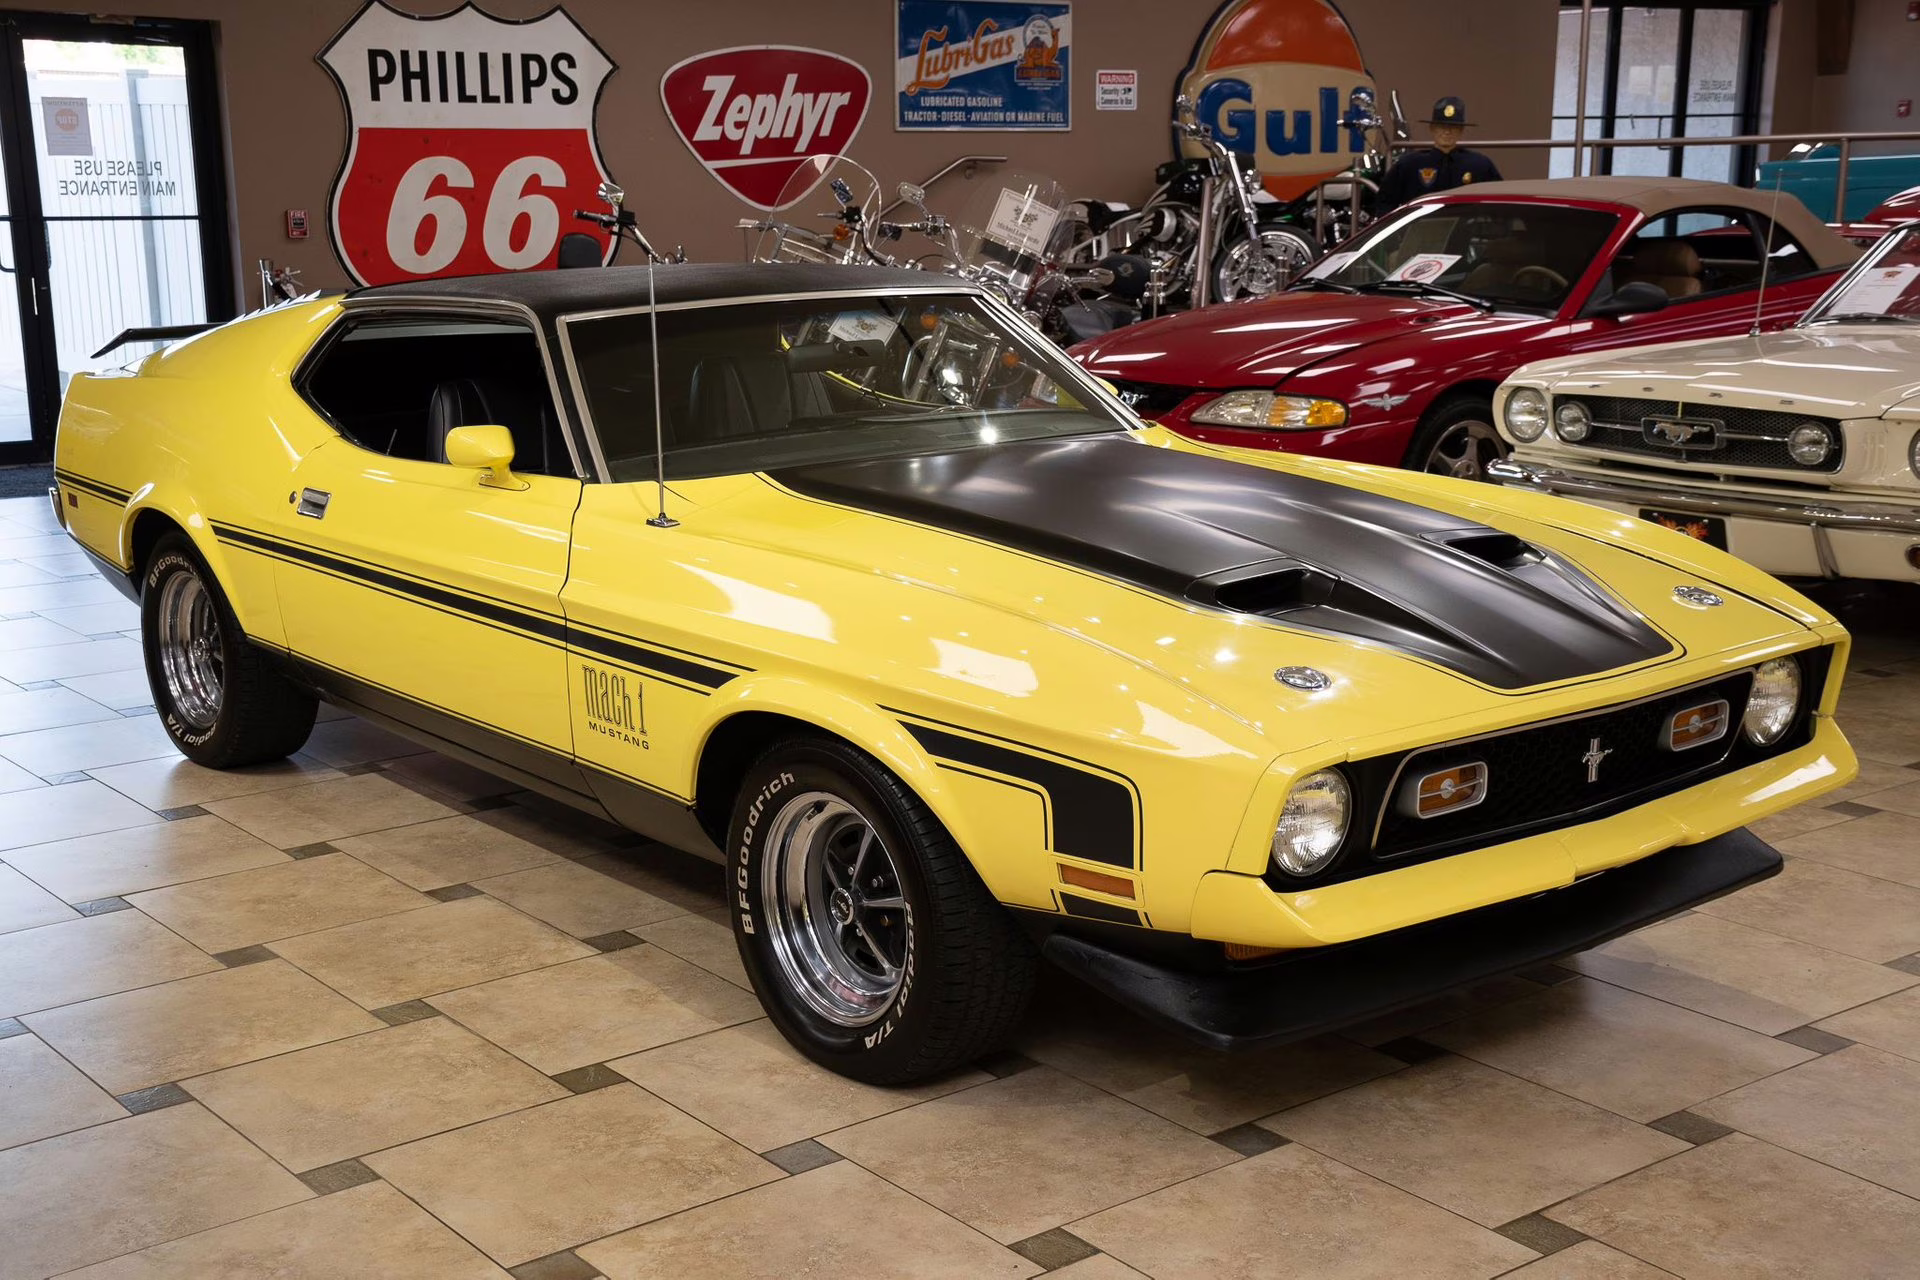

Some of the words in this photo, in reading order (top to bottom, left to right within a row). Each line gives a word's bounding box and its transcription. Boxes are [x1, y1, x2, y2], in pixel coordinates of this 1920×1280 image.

[367, 48, 579, 105] PHILLIPS
[1099, 74, 1134, 83] WARNING
[693, 73, 851, 155] Zephyr
[904, 111, 938, 122] TRACTOR
[941, 111, 967, 122] DIESEL
[970, 111, 1004, 122] AVIATION
[1005, 111, 1016, 122] OR
[1017, 112, 1045, 122] MARINE
[1047, 112, 1064, 122] FUEL
[920, 97, 966, 108] LUBRICATED
[966, 97, 1003, 108] GASOLINE
[1196, 78, 1374, 157] Gulf
[386, 155, 567, 274] 66
[149, 555, 202, 589] BFGoodri
[582, 664, 635, 732] mach
[638, 681, 647, 736] 1
[167, 713, 183, 738] T/A
[183, 722, 216, 747] Radial
[588, 720, 650, 750] MUSTANG
[737, 772, 796, 935] BFGoodrich
[897, 901, 915, 1018] Radial
[864, 1019, 896, 1050] T/A
